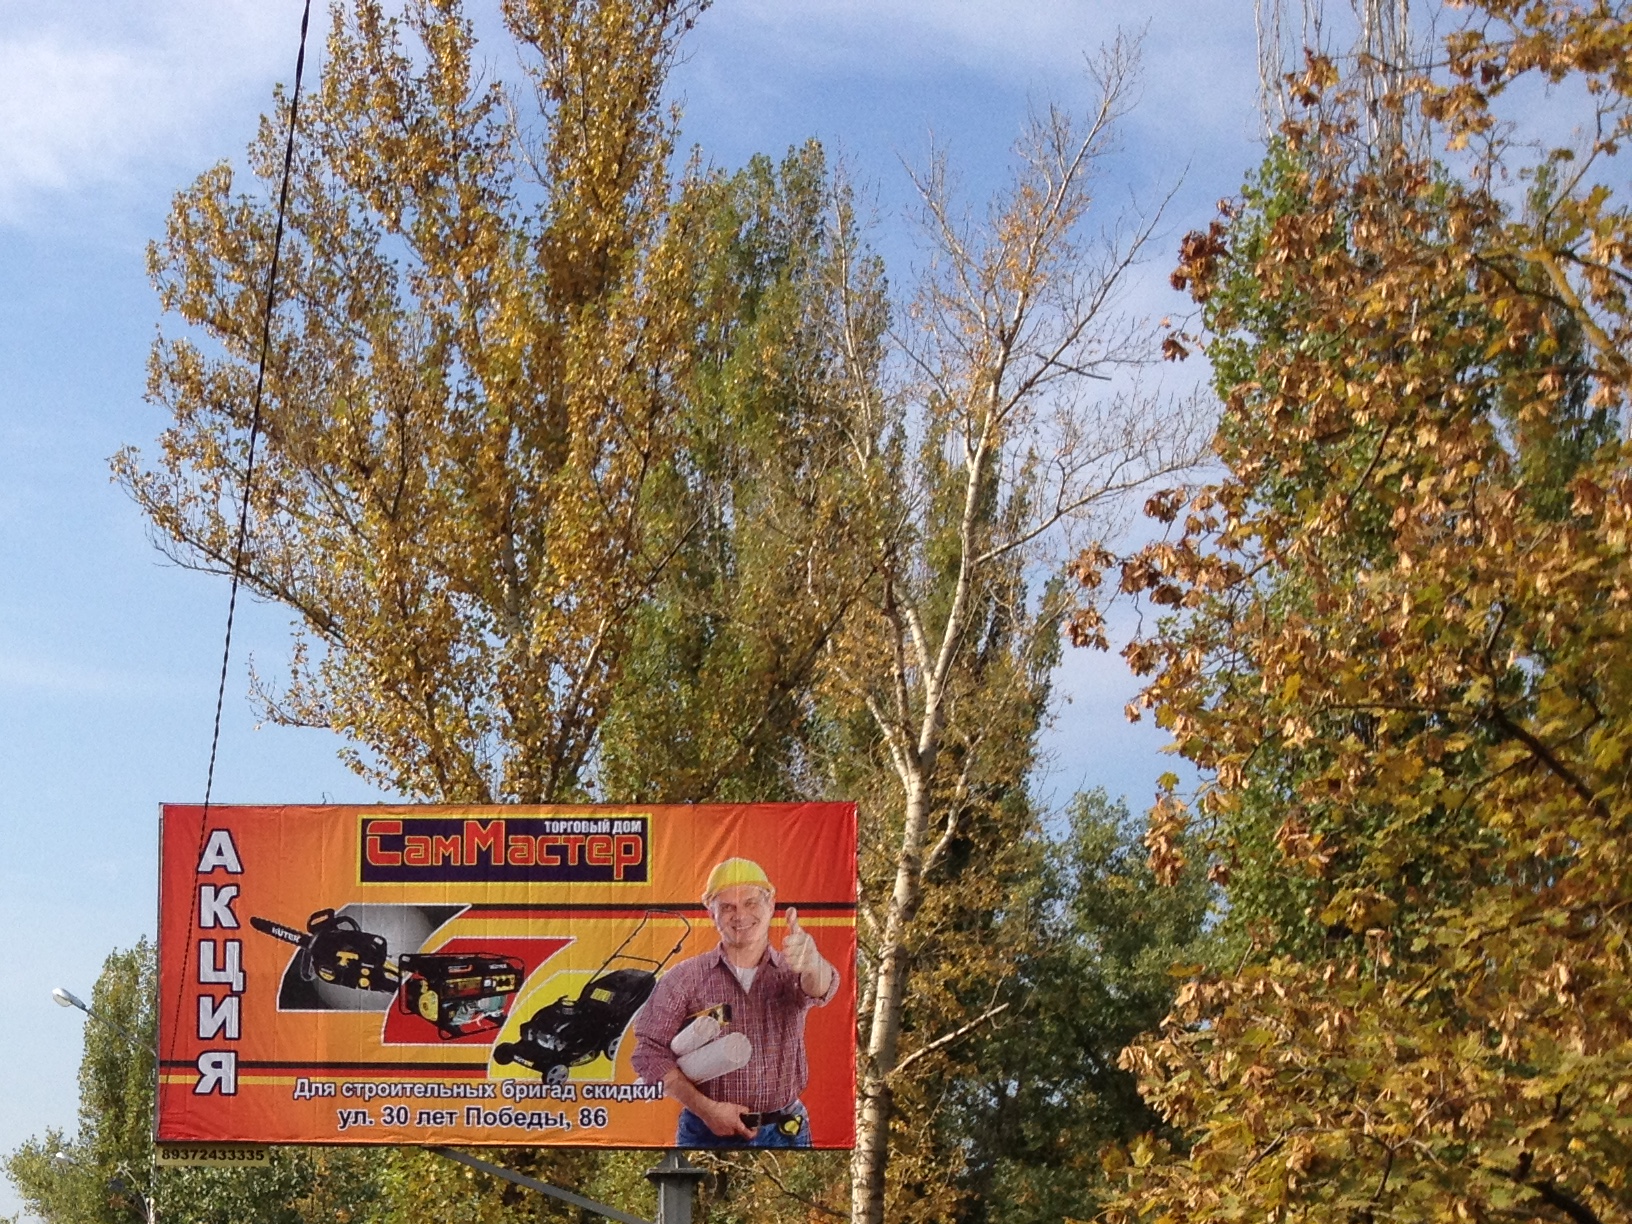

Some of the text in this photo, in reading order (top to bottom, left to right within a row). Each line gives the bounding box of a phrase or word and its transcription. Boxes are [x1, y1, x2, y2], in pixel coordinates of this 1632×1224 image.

[544, 819, 642, 834] ТОРГОВЫЙ ДОМ
[366, 820, 643, 880] СамМастер
[195, 828, 245, 1095] АКЦИЯ
[294, 1079, 663, 1102] Для строительных бригад скидки!
[337, 1106, 607, 1130] ул. 30 лет Победы, 86
[161, 1148, 265, 1160] 89372433335
